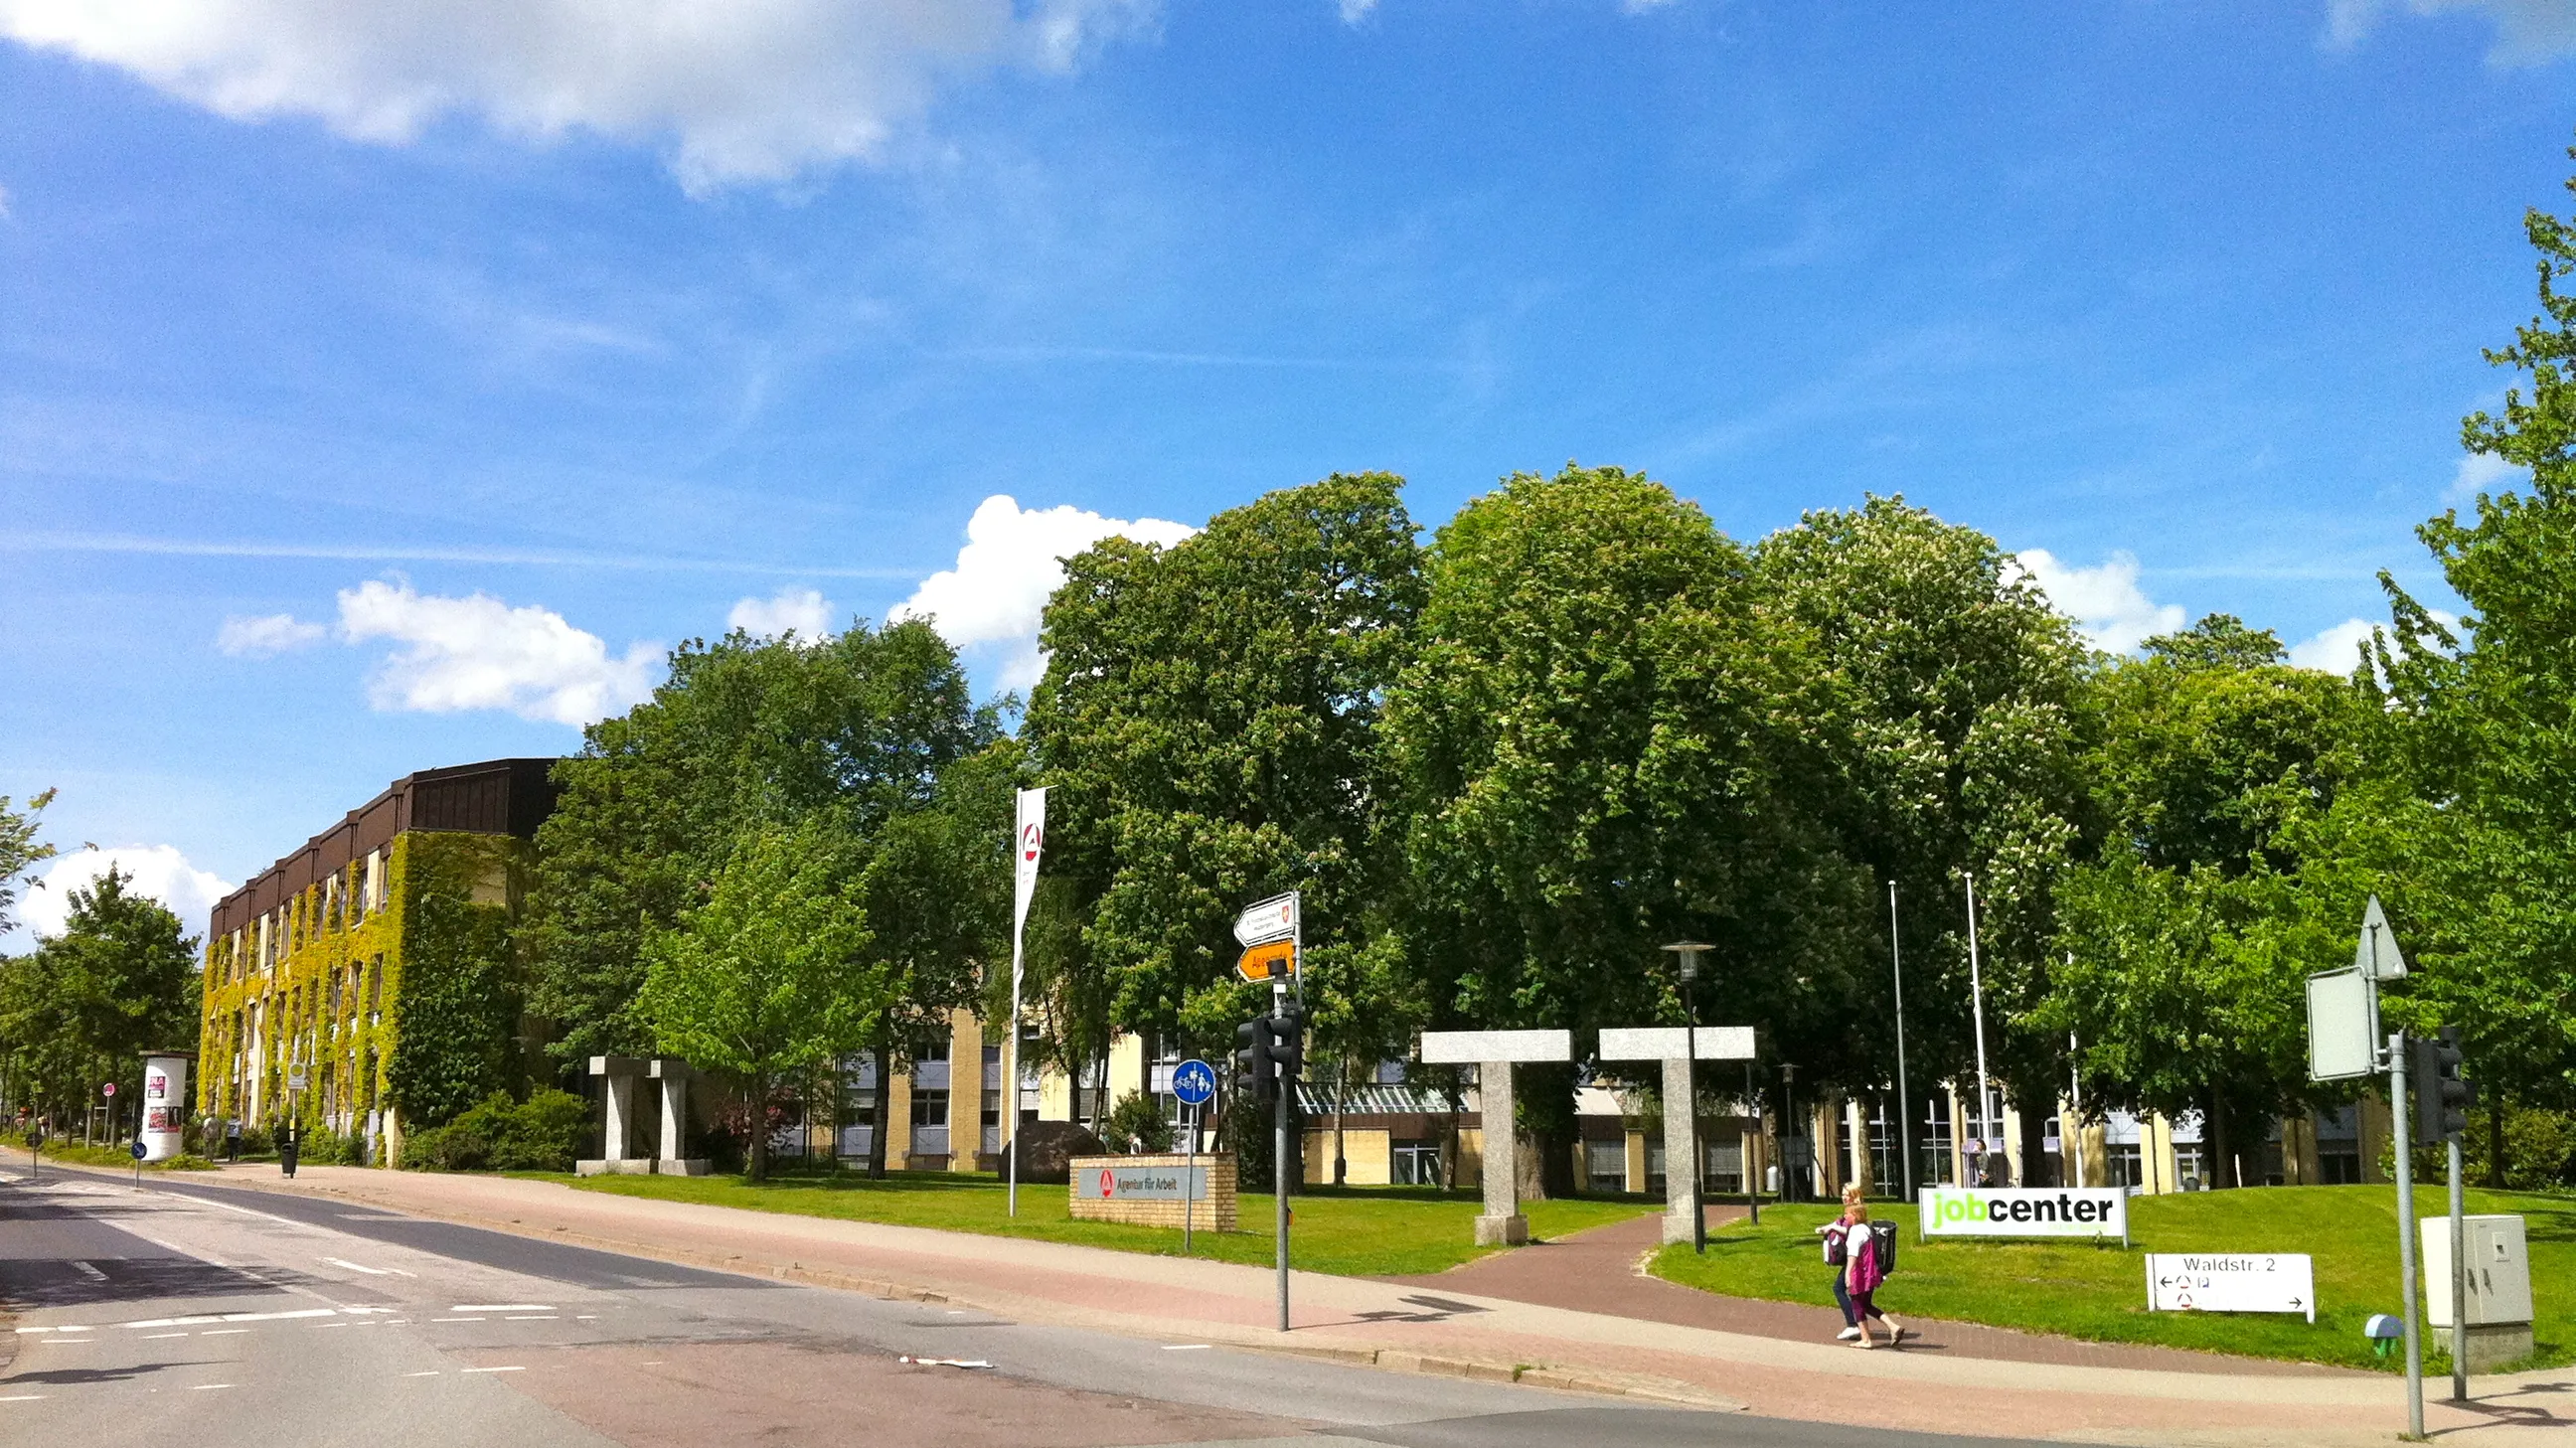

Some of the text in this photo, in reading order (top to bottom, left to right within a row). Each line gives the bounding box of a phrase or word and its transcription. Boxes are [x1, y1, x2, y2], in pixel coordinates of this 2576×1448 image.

[1117, 1177, 1177, 1193] Agentur für Arbeit
[1933, 1193, 2113, 1229] jobcenter
[2183, 1256, 2276, 1271] Waldstr. 2
